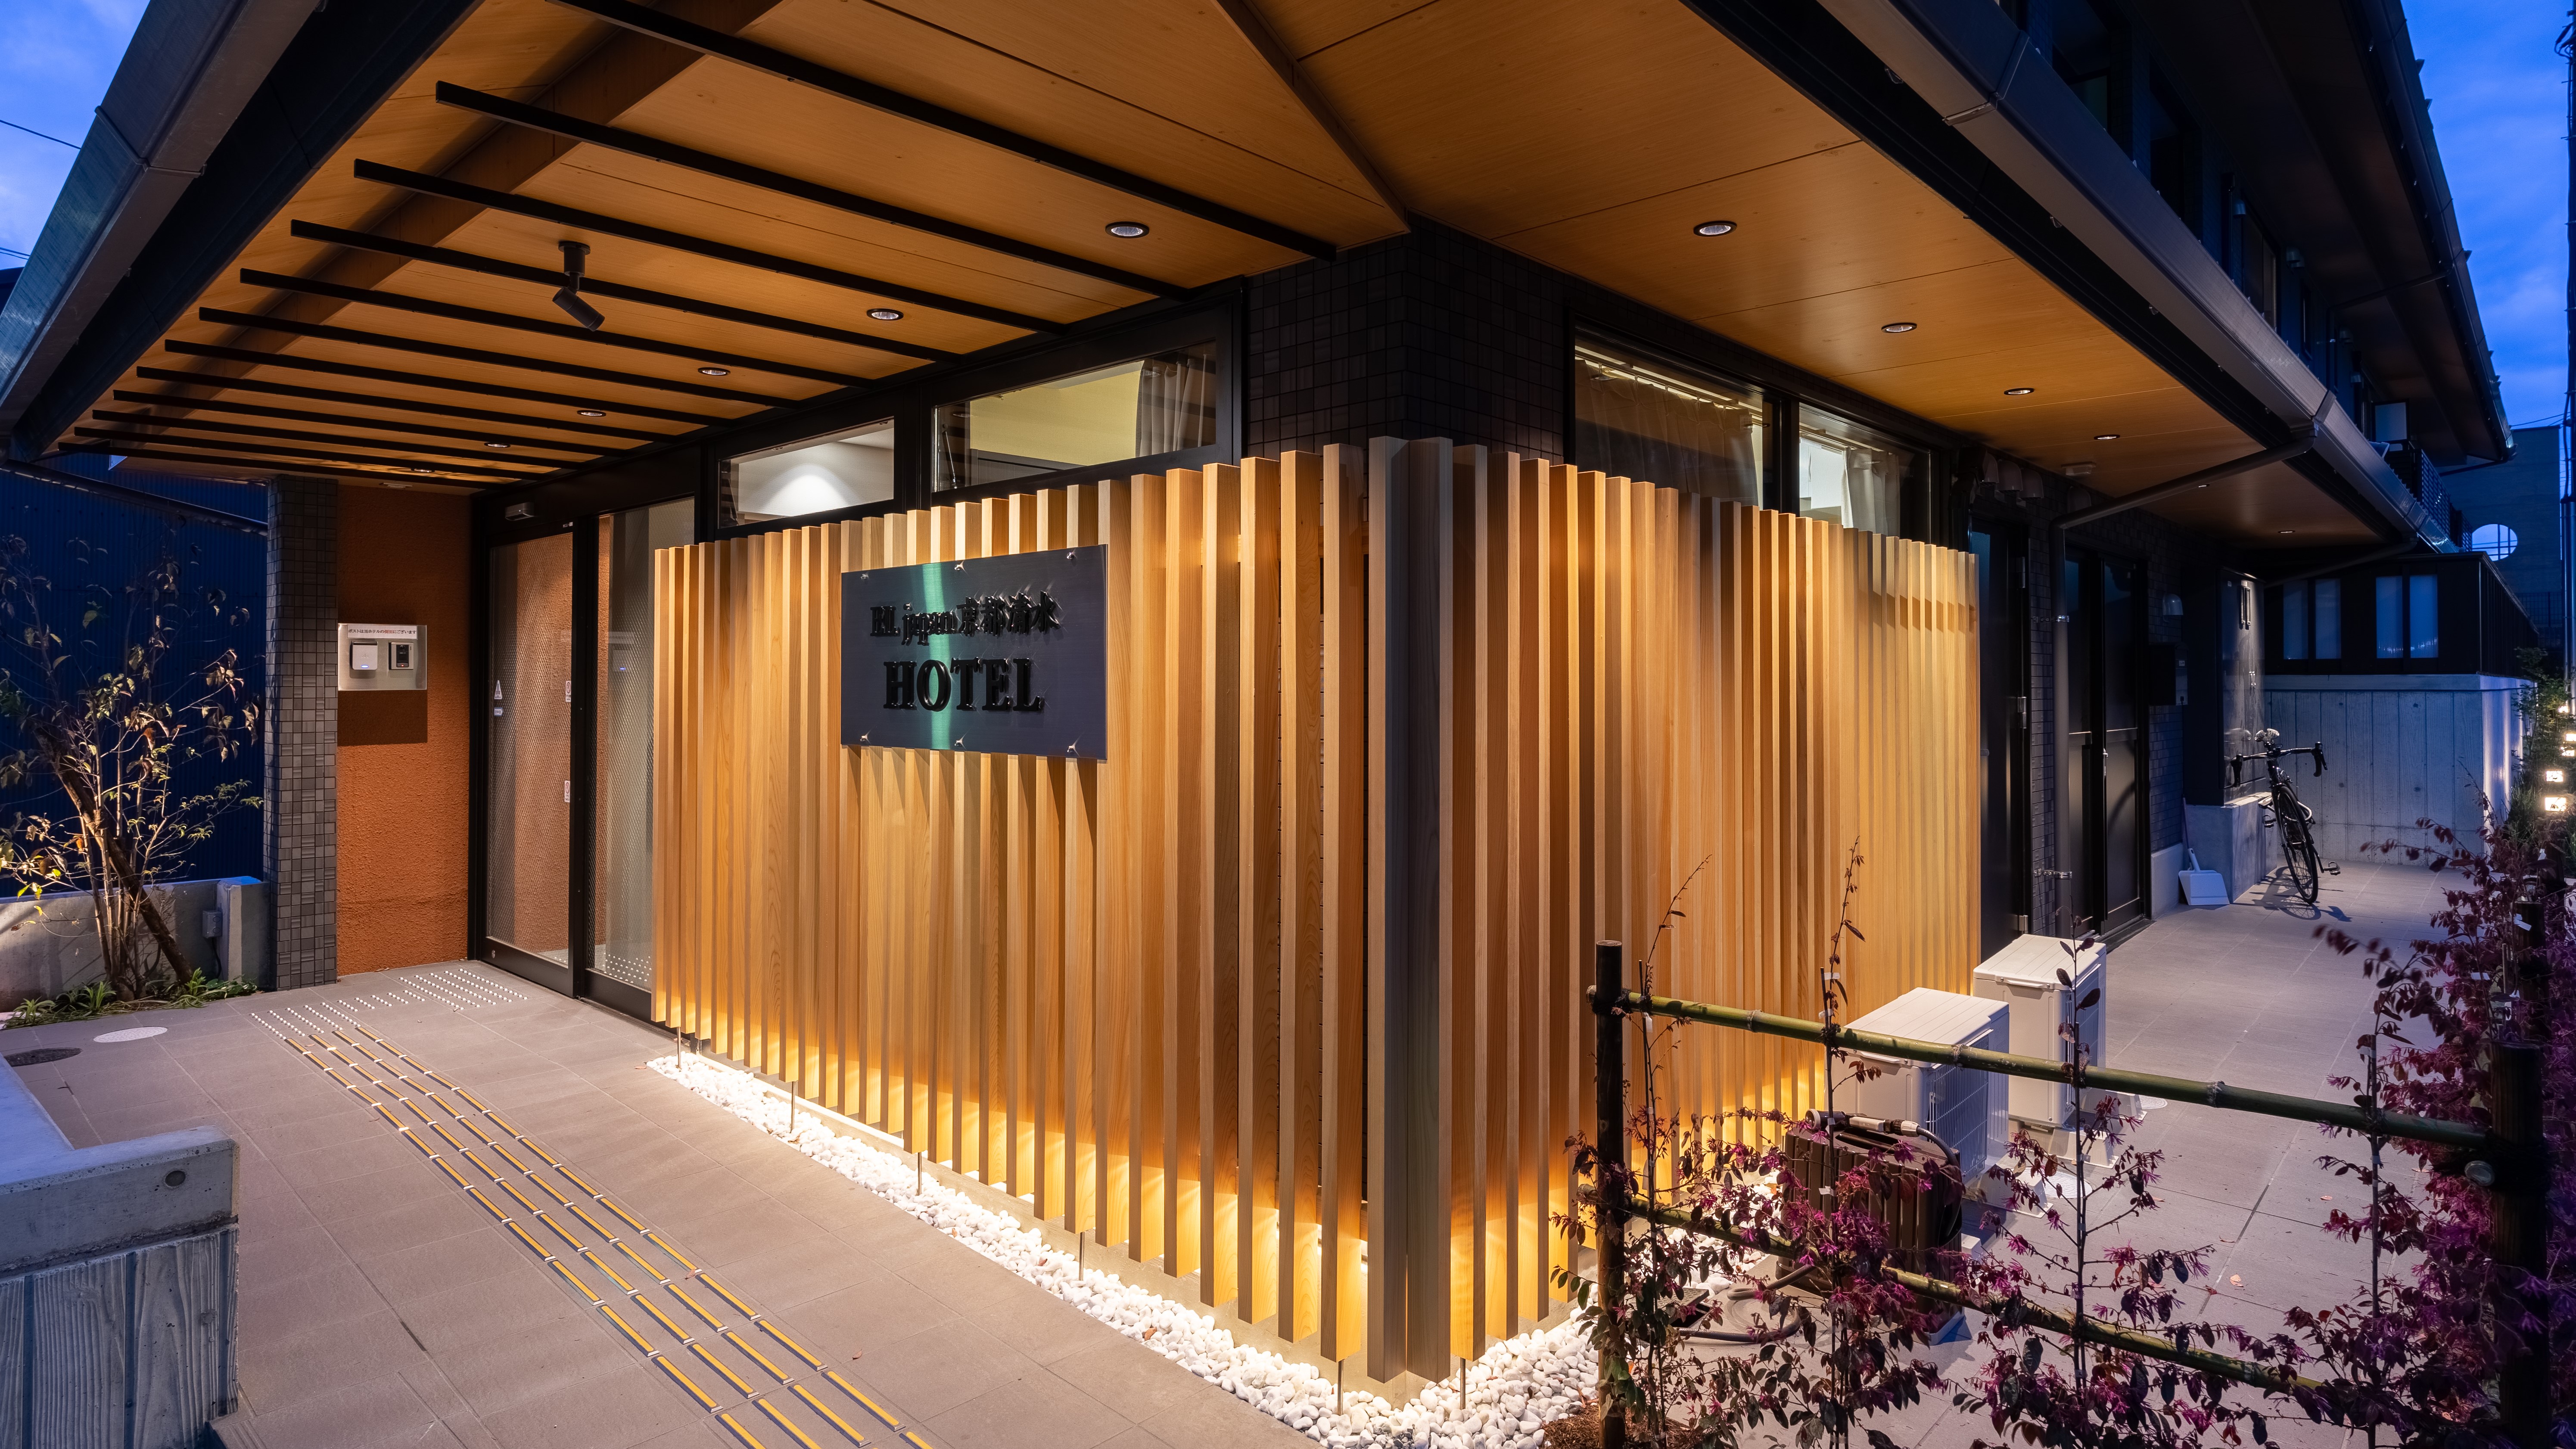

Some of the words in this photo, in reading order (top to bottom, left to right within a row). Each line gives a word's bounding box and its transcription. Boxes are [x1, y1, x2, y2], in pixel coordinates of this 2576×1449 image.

[901, 603, 958, 646] japan
[956, 590, 1061, 637] 京都清水
[883, 657, 1043, 712] HOTEL
